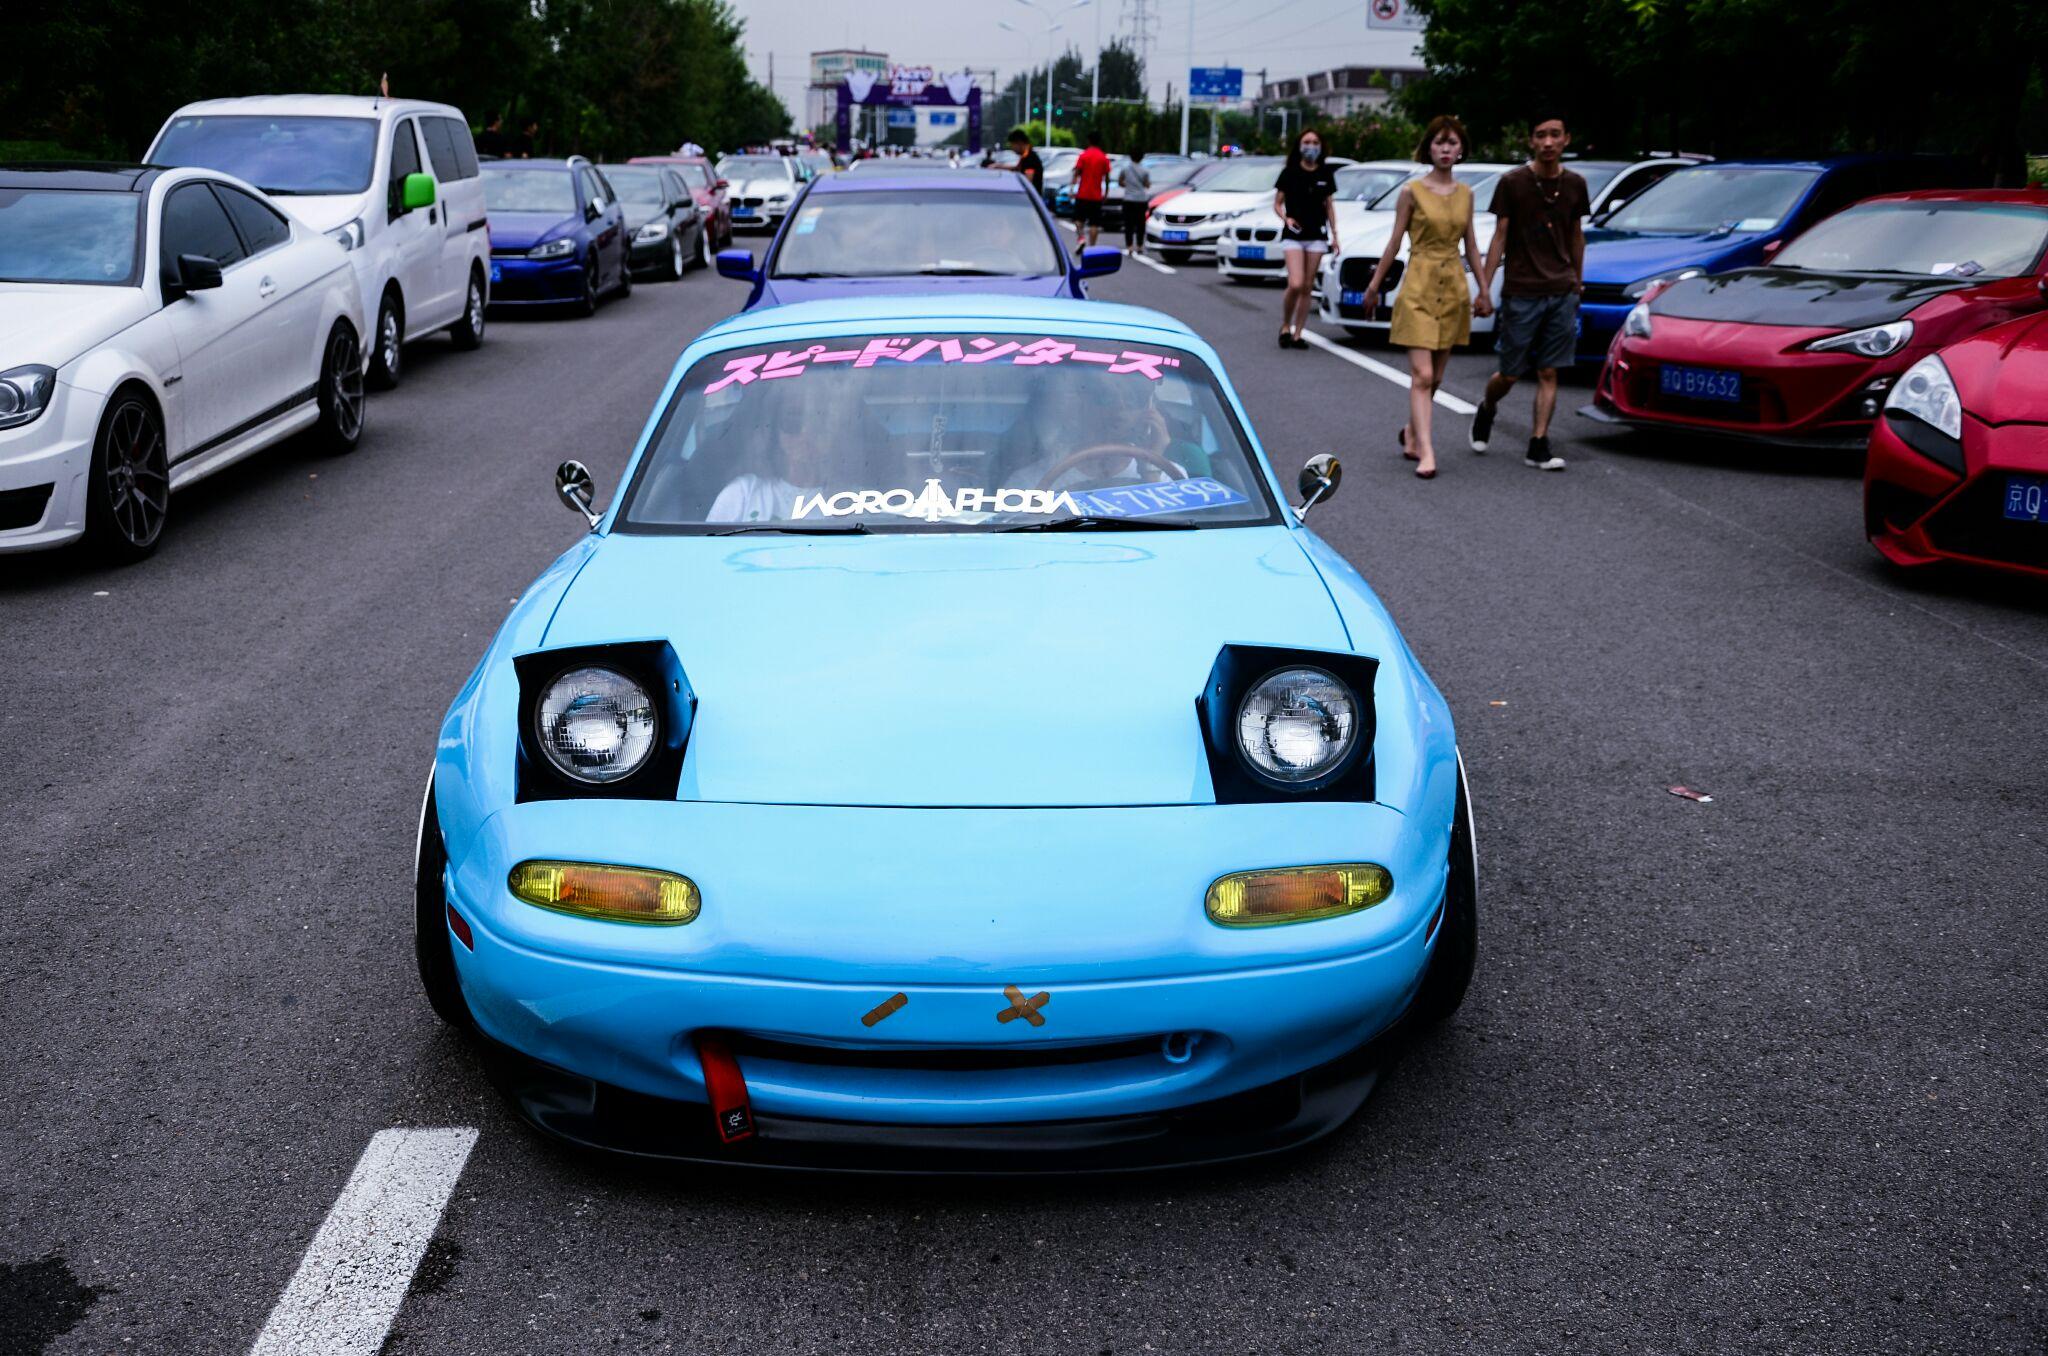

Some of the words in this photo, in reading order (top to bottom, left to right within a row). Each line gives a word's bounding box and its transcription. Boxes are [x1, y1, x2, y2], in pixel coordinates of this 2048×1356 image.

[704, 337, 1180, 395] スピードハンターズ
